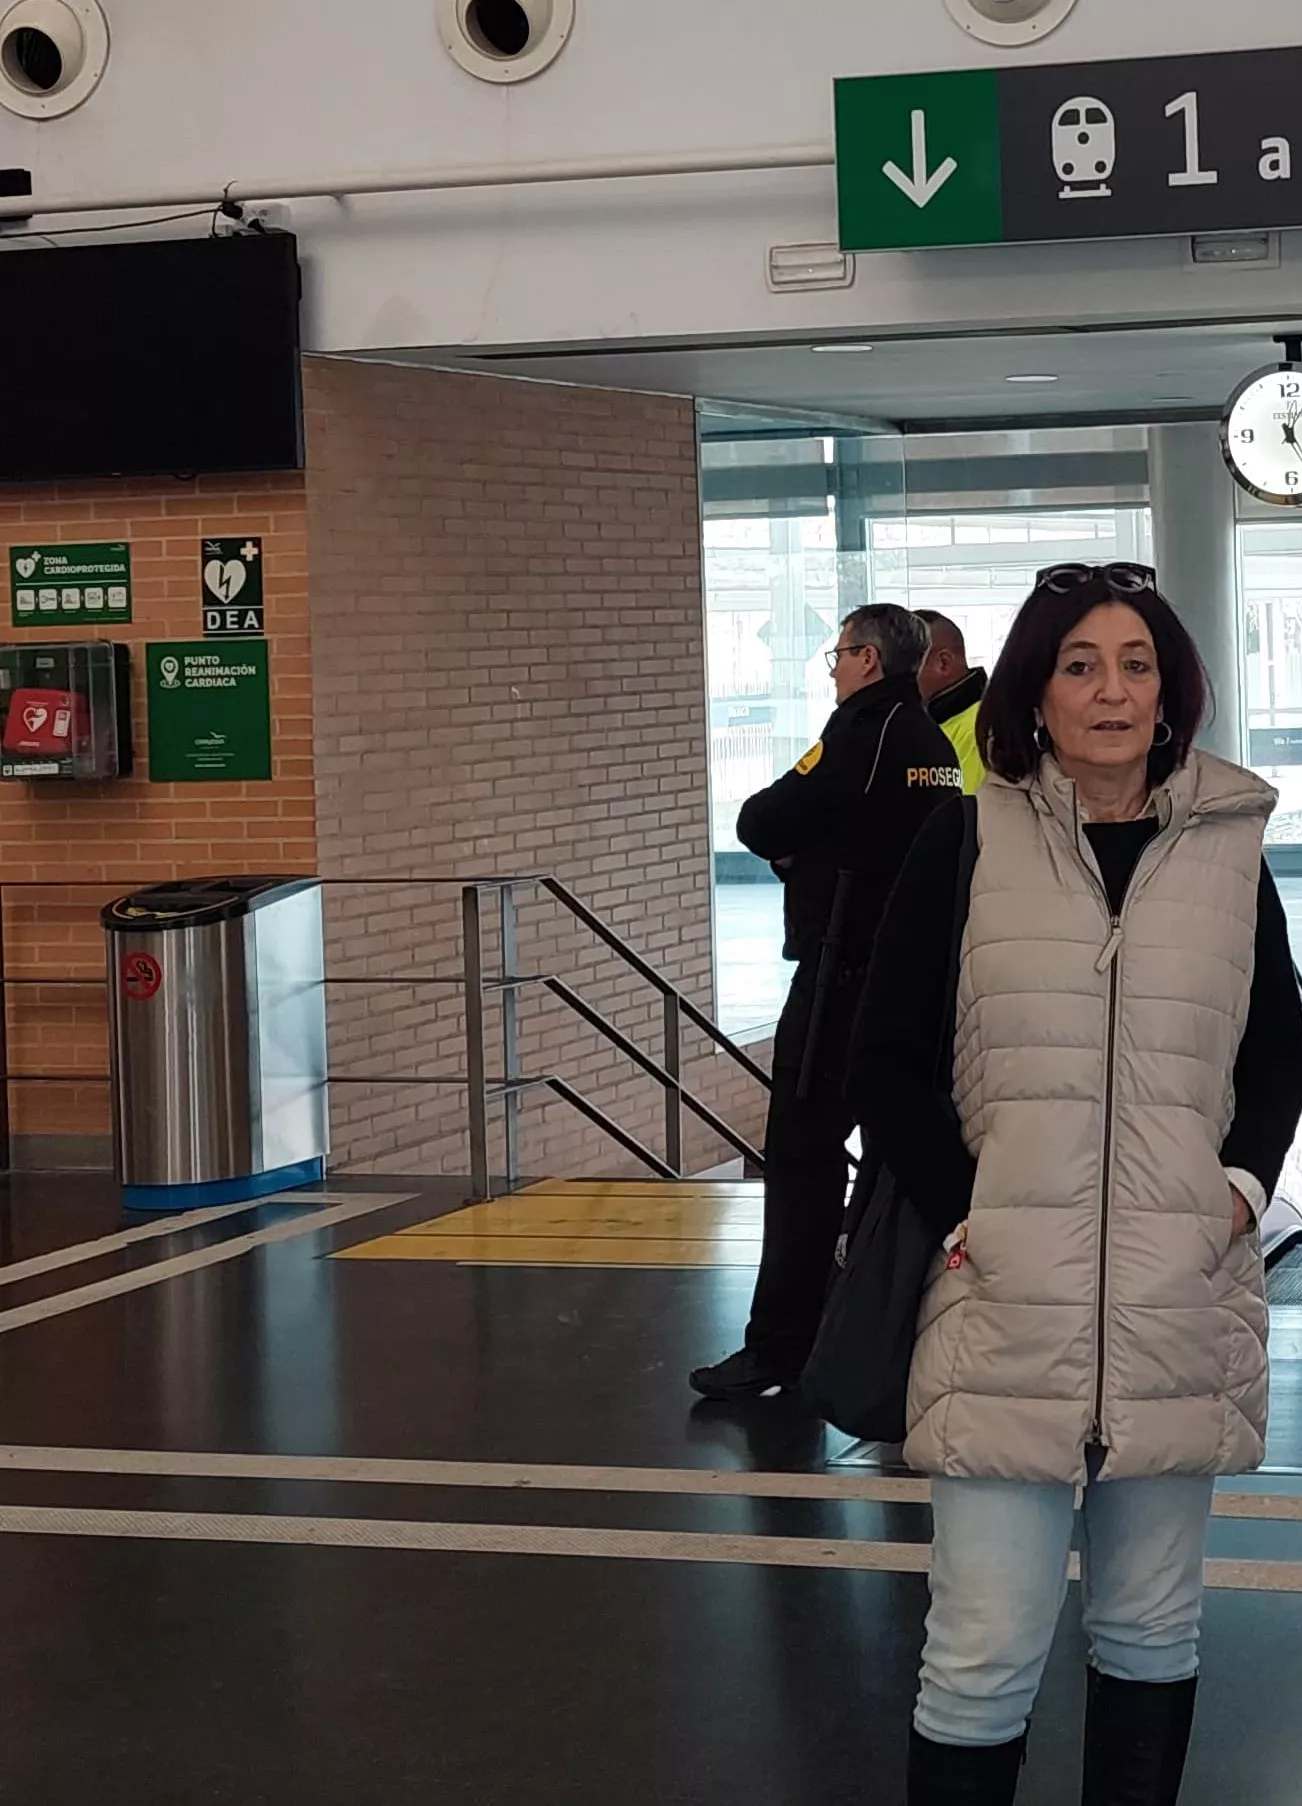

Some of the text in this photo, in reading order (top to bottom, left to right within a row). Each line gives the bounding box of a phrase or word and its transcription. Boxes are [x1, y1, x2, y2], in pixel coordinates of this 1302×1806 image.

[1164, 91, 1218, 187] 1
[1258, 134, 1292, 181] a
[1277, 382, 1301, 398] 12
[1240, 428, 1255, 444] 9
[1285, 471, 1299, 486] 6
[43, 556, 68, 565] ZONA
[43, 563, 126, 575] CARDIOPROTEGIDA
[206, 610, 260, 630] DEA
[184, 655, 220, 666] PUNTO
[184, 663, 257, 677] REANIMACIÓN
[184, 677, 237, 688] CARDIACA
